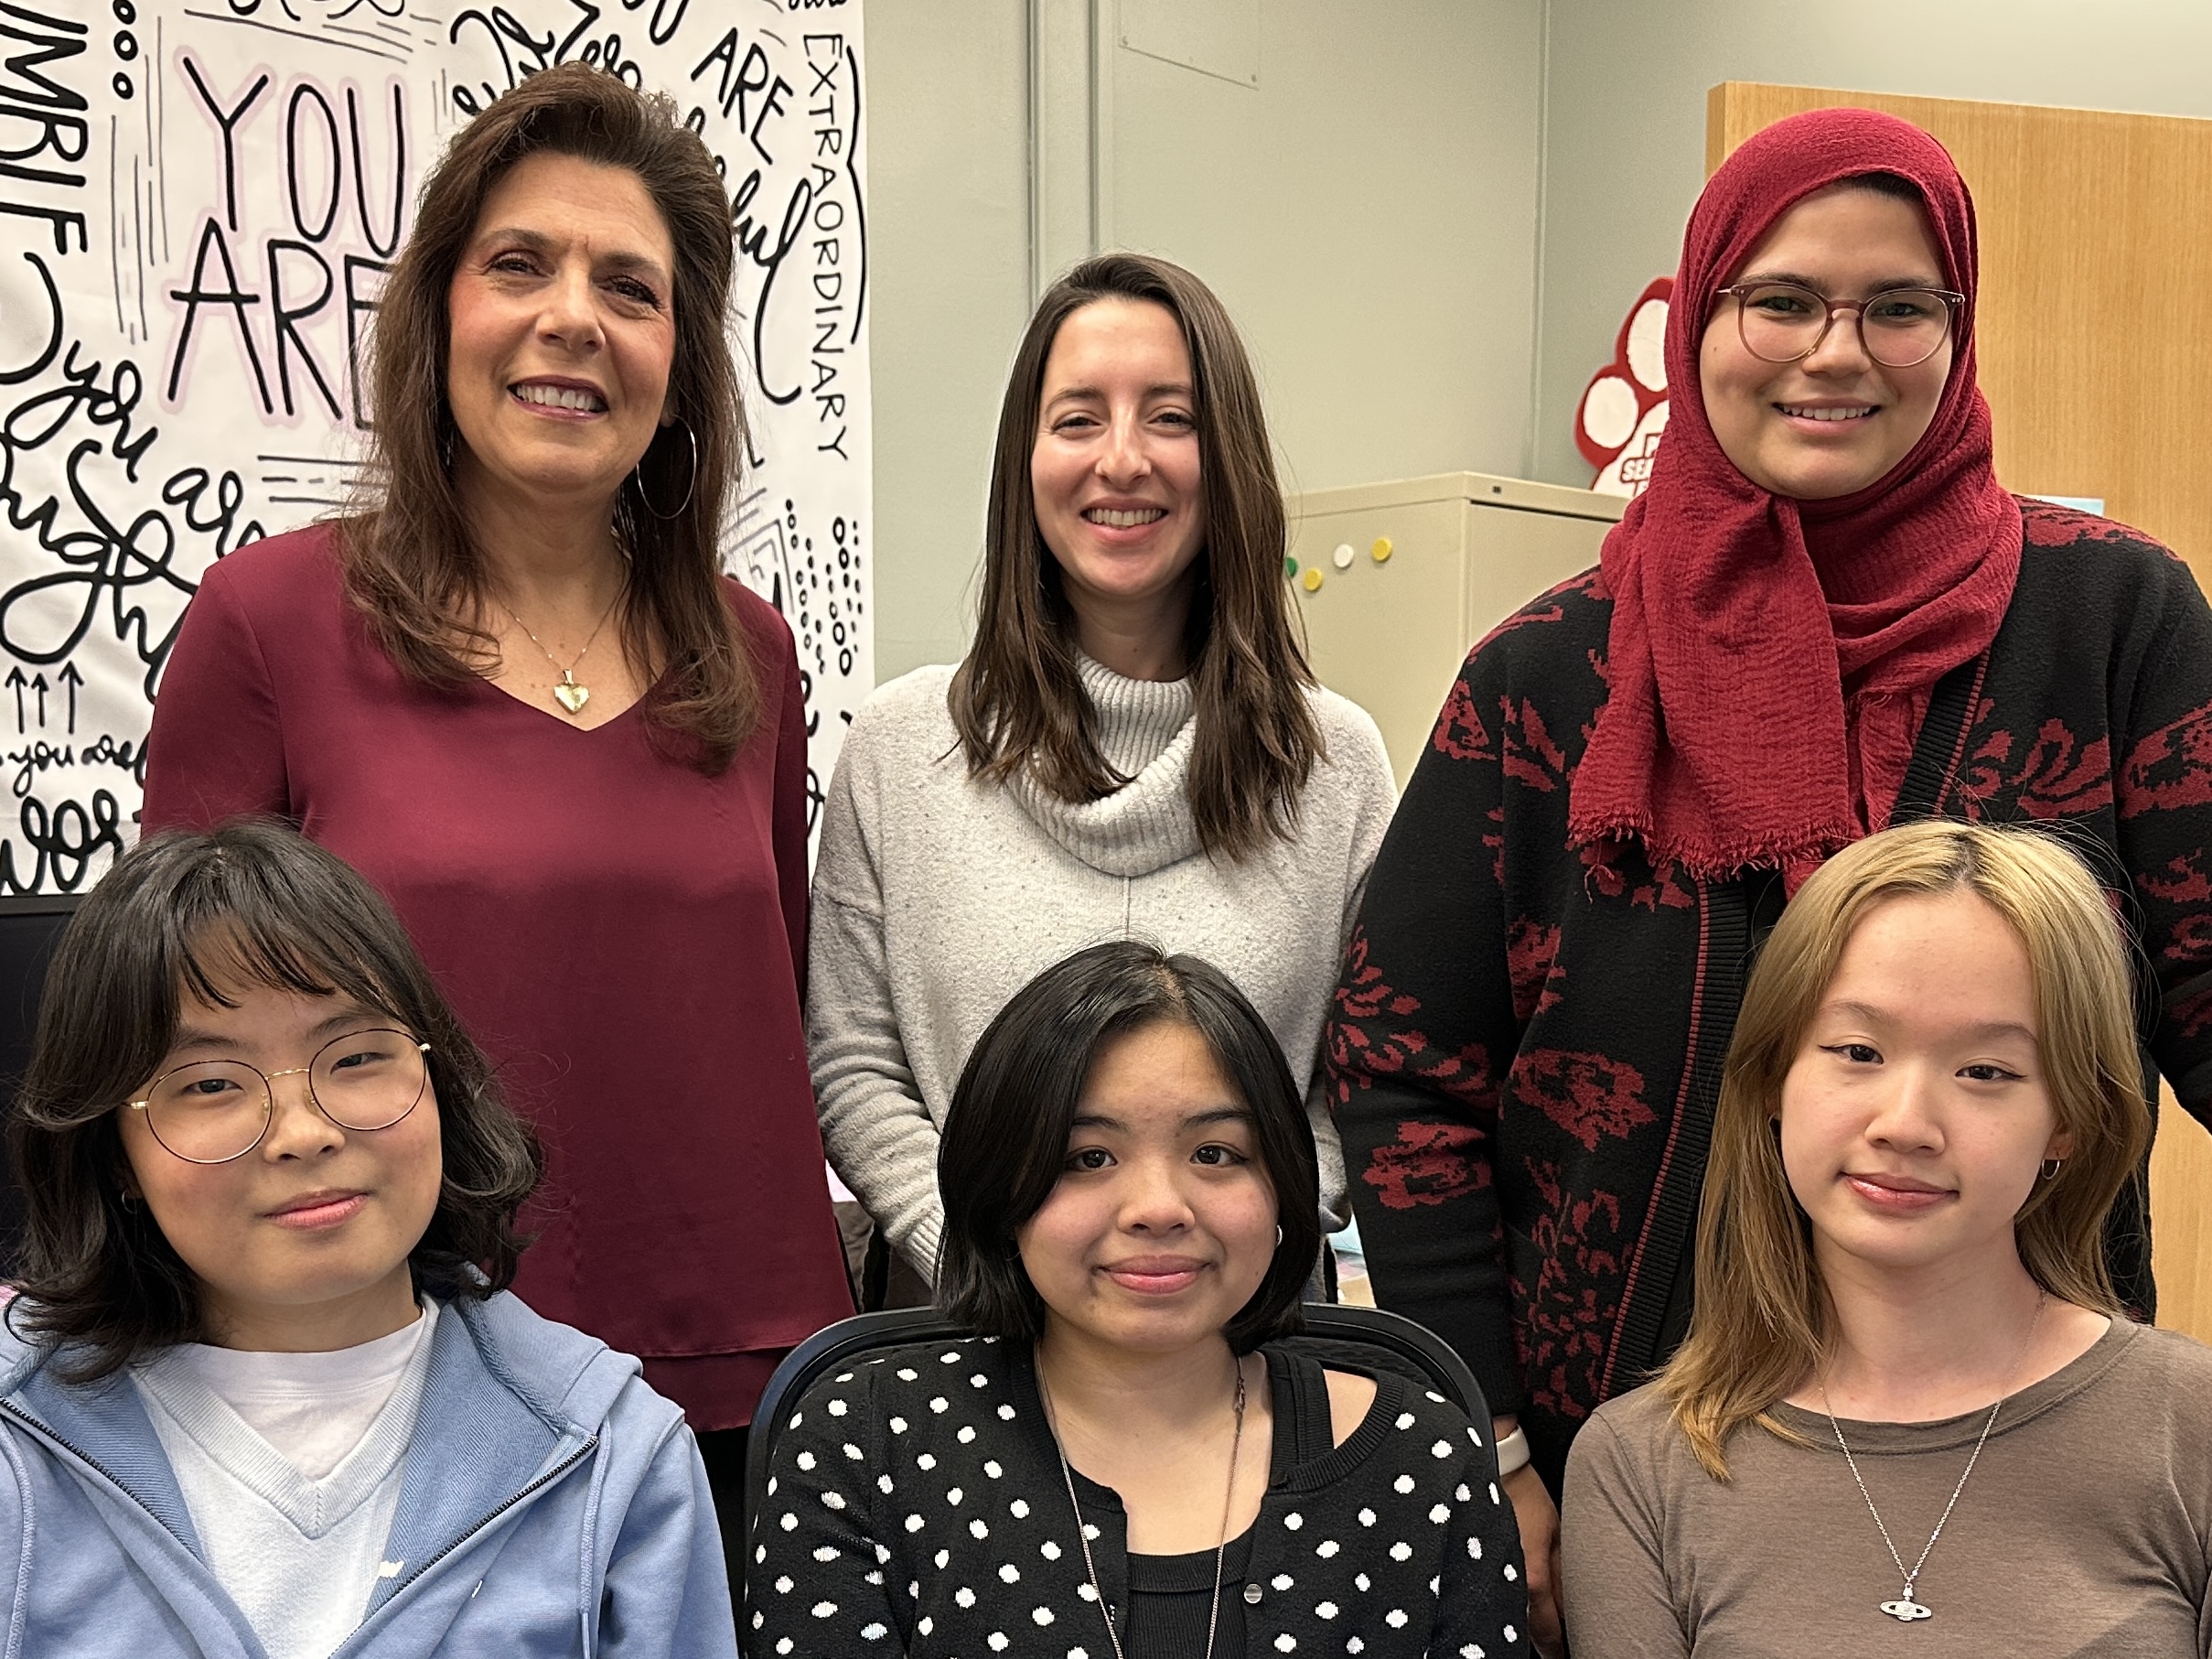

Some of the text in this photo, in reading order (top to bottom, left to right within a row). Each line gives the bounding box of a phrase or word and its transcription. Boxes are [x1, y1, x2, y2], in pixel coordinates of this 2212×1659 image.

[183, 57, 405, 258] YOU
[691, 27, 794, 165] ARE
[170, 217, 393, 431] ARE
[803, 34, 848, 459] EXTRAORDINARY
[5, 339, 158, 483] you
[8, 740, 75, 798] you
